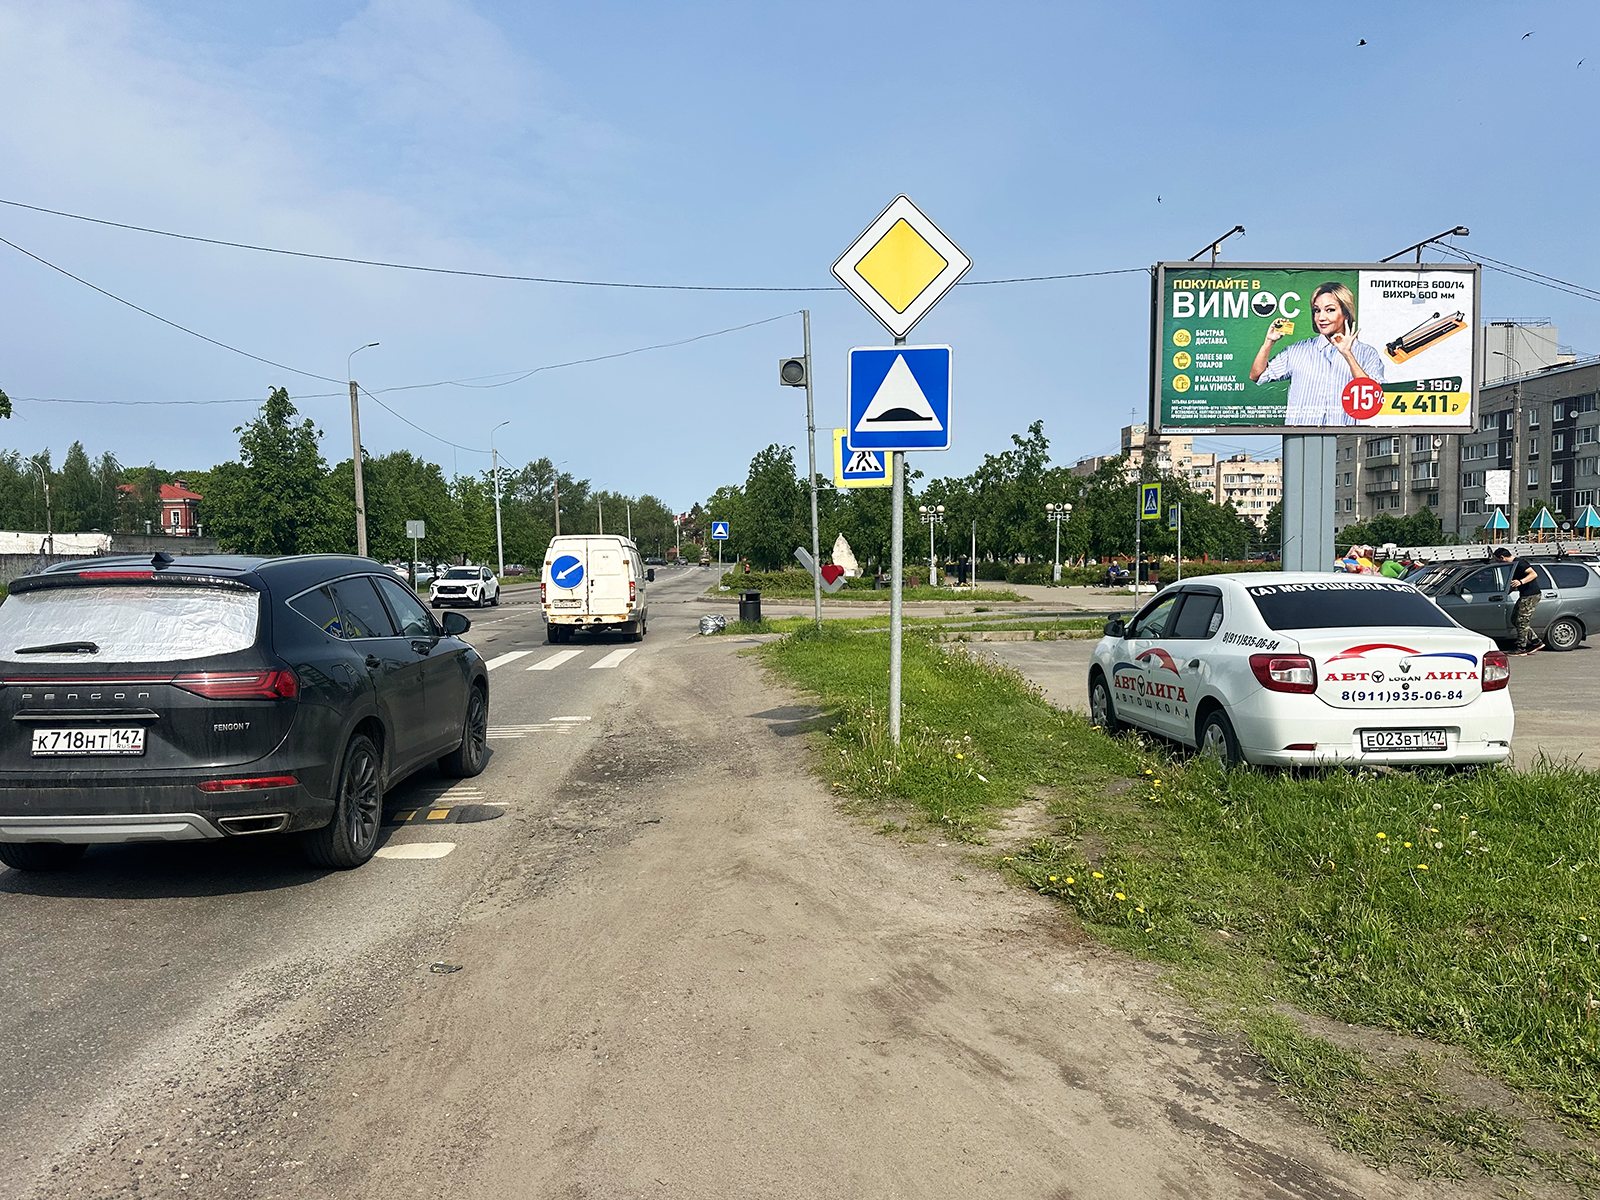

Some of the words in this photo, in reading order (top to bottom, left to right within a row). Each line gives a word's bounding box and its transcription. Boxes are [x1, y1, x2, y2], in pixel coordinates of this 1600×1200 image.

[1173, 278, 1249, 290] ПОКУПАЙТЕ
[1252, 280, 1261, 290] В
[1370, 280, 1429, 289] ПЛИТКОРЕЗ
[1432, 281, 1465, 290] 600/14
[1383, 290, 1416, 299] ВИХРЬ
[1418, 291, 1438, 299] 600
[1172, 291, 1301, 319] ВИМОС
[1195, 337, 1227, 345] ДОСТАВКА
[1209, 383, 1244, 391] VIMOS.RU
[1343, 385, 1385, 410] -15%
[1250, 587, 1276, 596] (А)
[1278, 582, 1388, 593] МОТОШКОЛА
[1222, 632, 1280, 650] 8(911)935-06-84
[1424, 671, 1479, 680] ЛИГА
[1341, 690, 1464, 702] 8(911)935-06-84
[1115, 692, 1190, 719] АВТОШКОЛА
[213, 722, 244, 732] FENGON
[244, 722, 251, 730] 7
[38, 731, 108, 750] К718НТ
[112, 730, 140, 744] 147
[1366, 732, 1420, 747] Е023ВТ
[1423, 731, 1442, 742] 147
